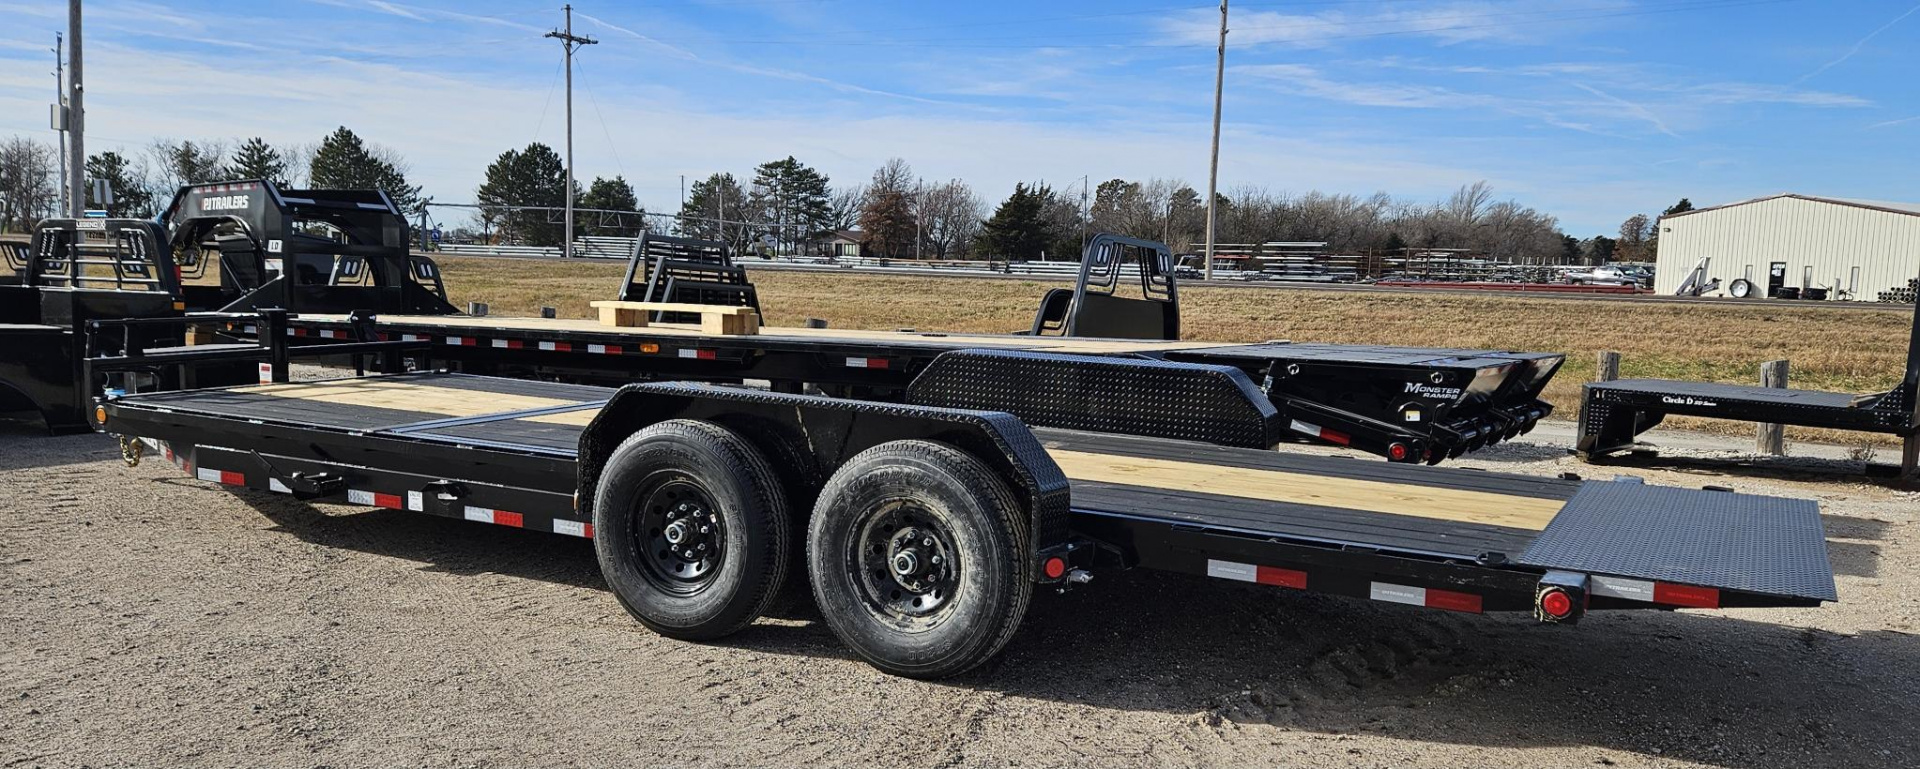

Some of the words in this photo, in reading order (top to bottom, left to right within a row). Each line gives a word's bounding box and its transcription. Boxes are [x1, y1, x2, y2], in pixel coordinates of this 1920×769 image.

[212, 195, 249, 210] TRAILERS
[1662, 396, 1685, 404] Circle
[1686, 397, 1693, 405] D
